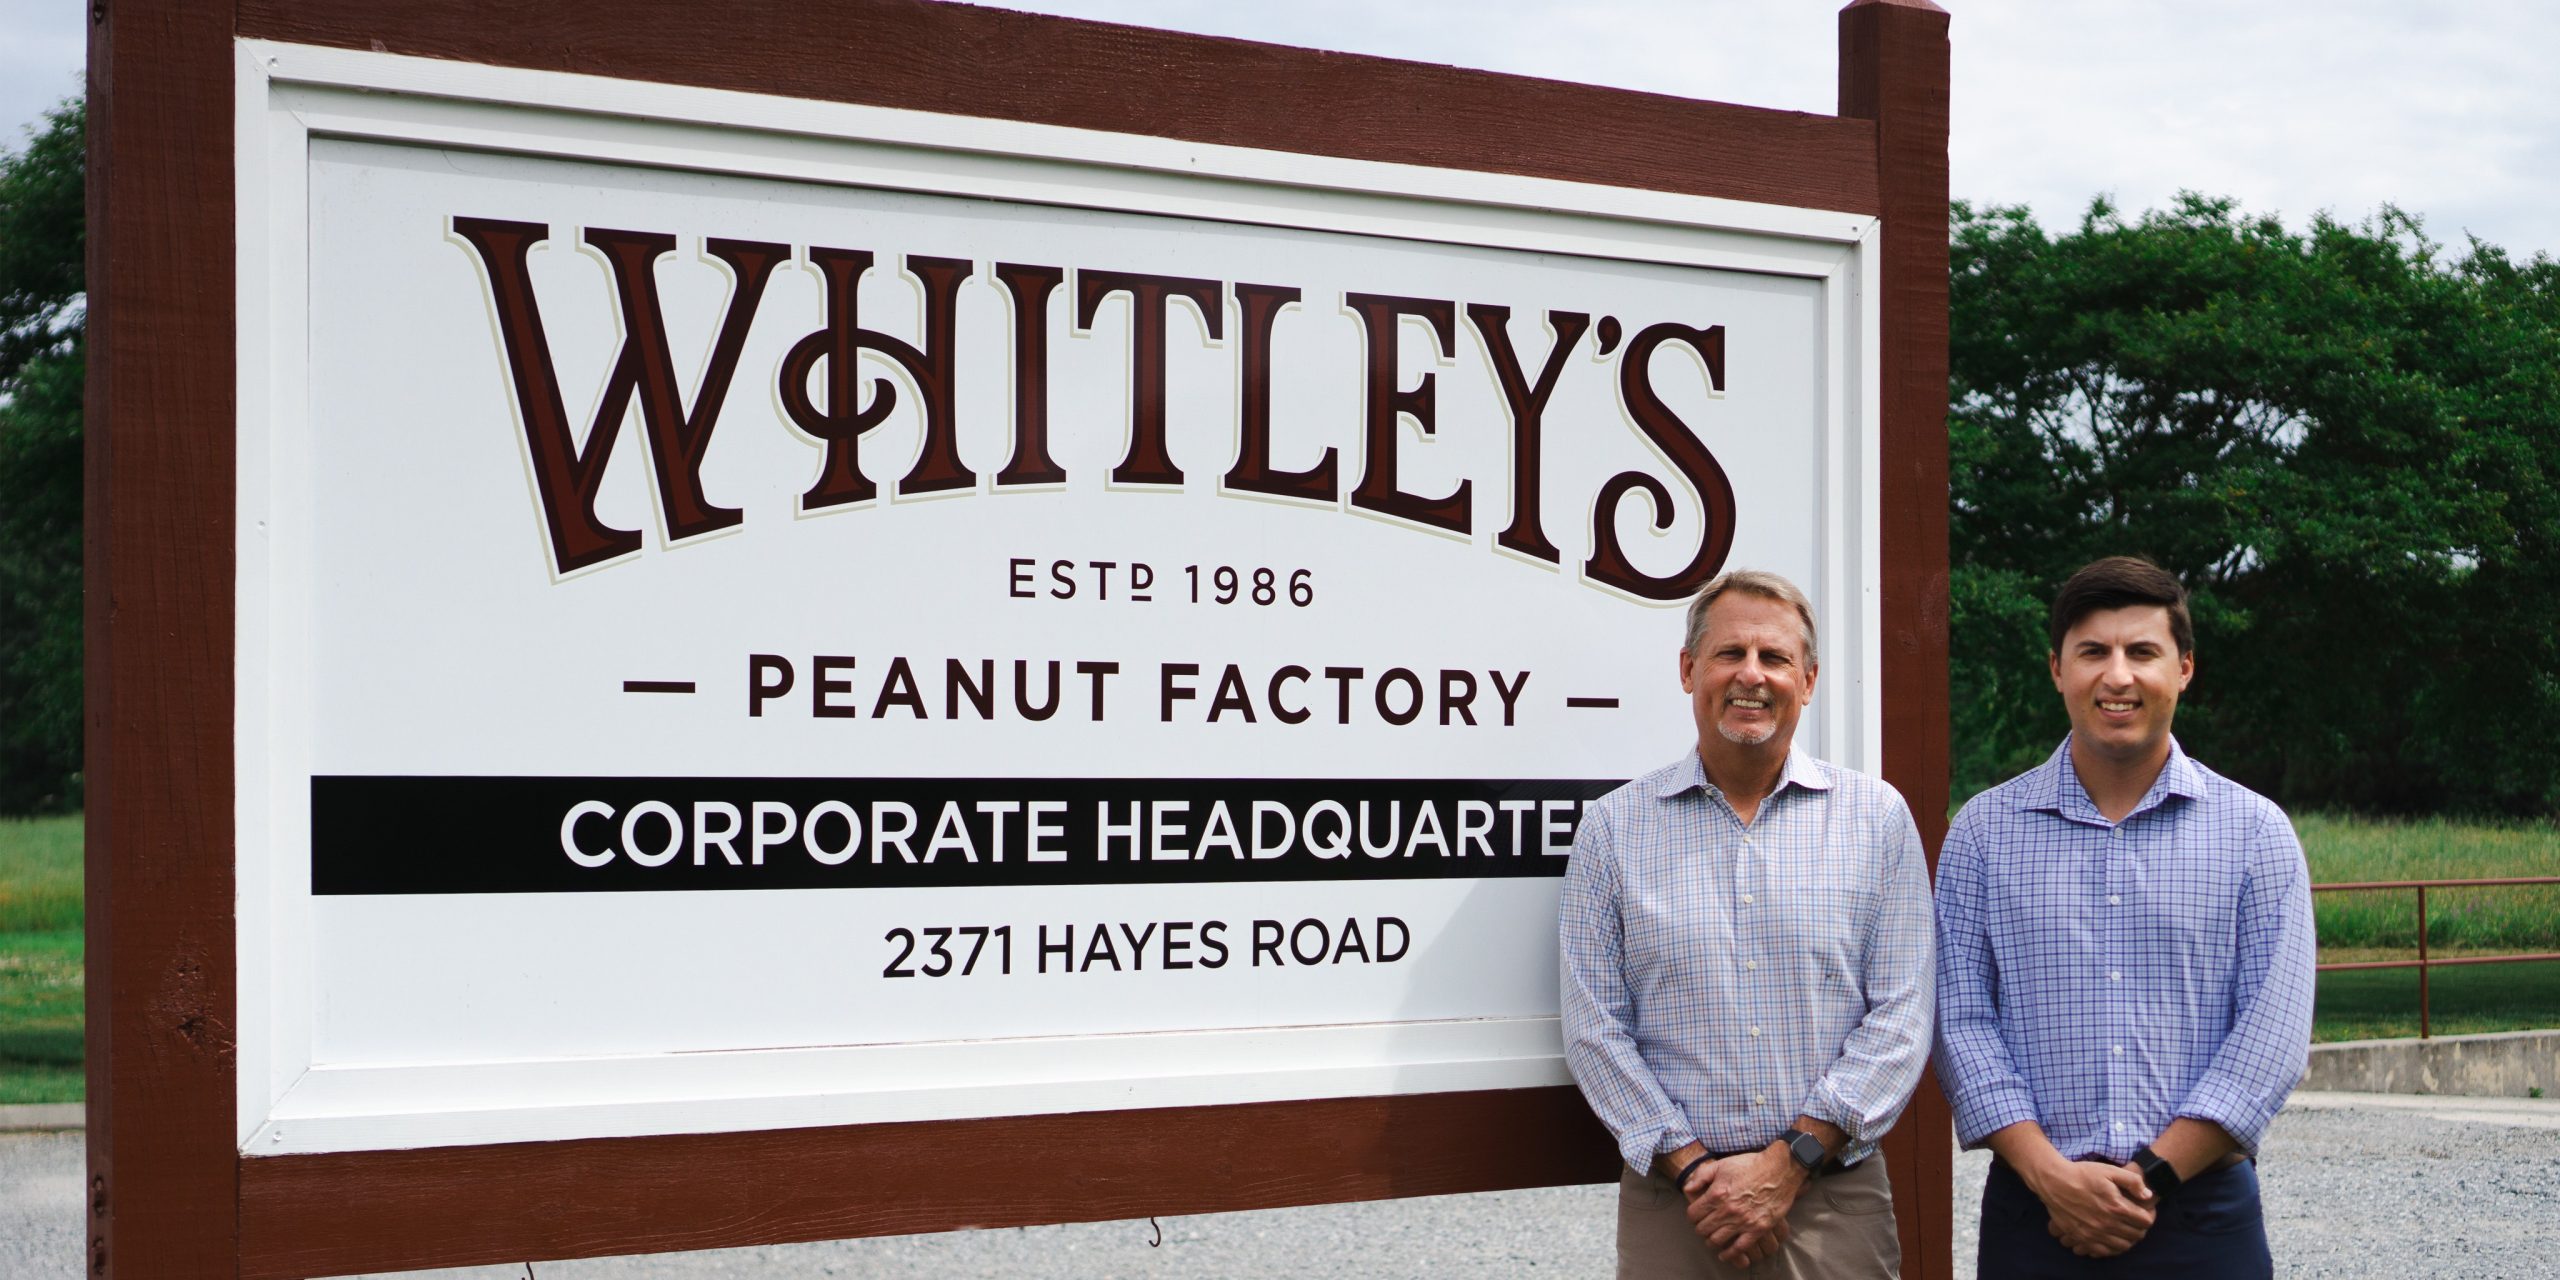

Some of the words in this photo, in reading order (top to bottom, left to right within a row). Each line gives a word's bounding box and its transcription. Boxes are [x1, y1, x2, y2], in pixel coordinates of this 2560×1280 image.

[448, 215, 1737, 604] WHITLEY'S
[1184, 564, 1314, 608] 1986
[749, 653, 1121, 722] PEANUT
[1160, 662, 1532, 727] FACTORY
[560, 799, 1069, 868] CORPORATE
[1097, 799, 1597, 861] HEADQUARTE
[882, 926, 1012, 979] 2371
[1037, 920, 1230, 974] HAYES
[1252, 916, 1411, 967] ROAD
